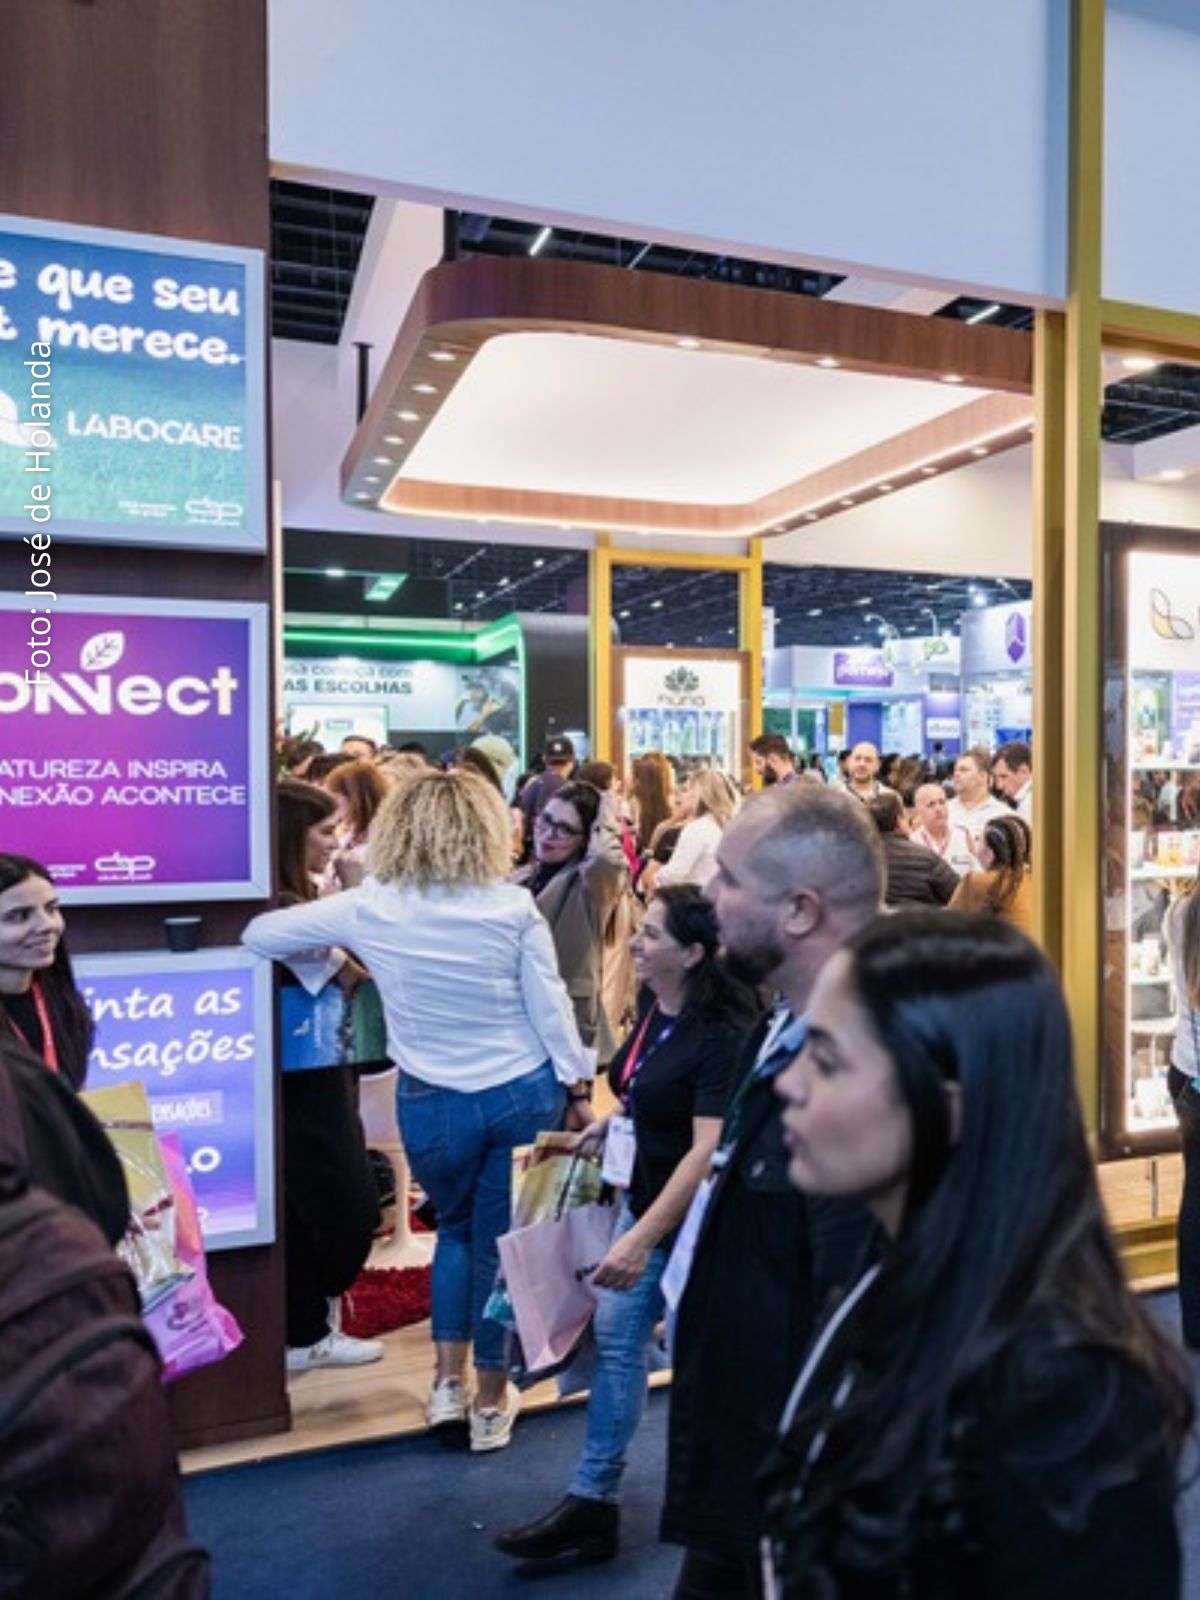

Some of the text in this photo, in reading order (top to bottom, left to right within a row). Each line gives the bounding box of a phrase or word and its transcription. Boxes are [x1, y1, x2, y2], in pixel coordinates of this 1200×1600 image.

[37, 263, 134, 312] que
[152, 277, 240, 317] seu
[37, 316, 241, 365] merece.
[67, 411, 242, 450] LABOCARE
[314, 679, 412, 693] ESCOLHAS
[127, 758, 228, 779] INSPIRA
[101, 785, 246, 806] ACONTECE
[194, 987, 241, 1015] as
